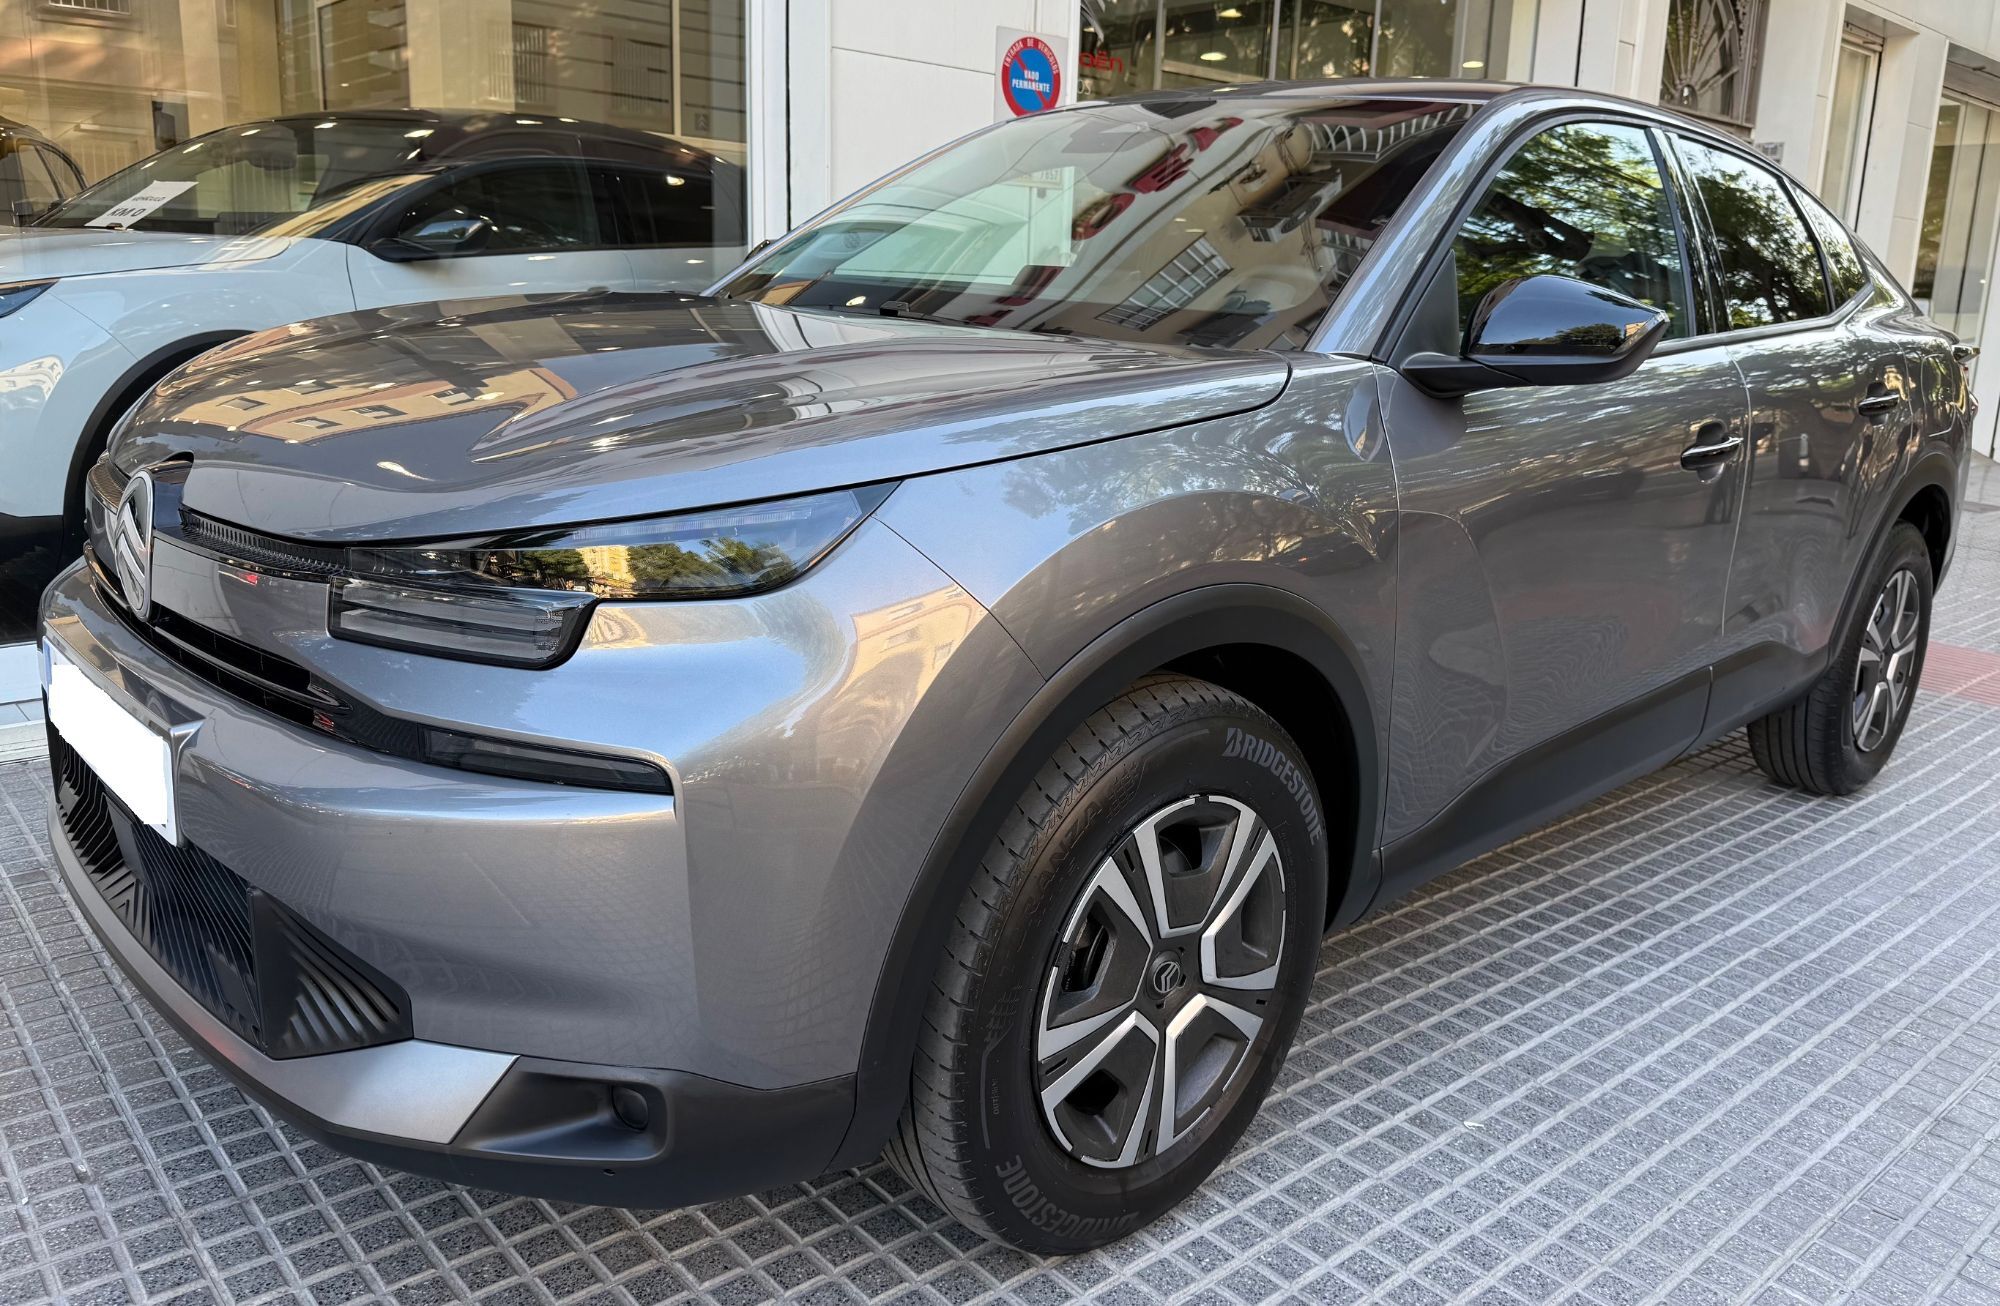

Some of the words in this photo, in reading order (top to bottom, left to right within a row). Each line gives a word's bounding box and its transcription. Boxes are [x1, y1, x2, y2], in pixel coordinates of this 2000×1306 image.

[1004, 40, 1024, 68] ENTRADA
[1026, 38, 1034, 48] DE
[1011, 78, 1050, 93] PERMANENTE
[1023, 69, 1040, 80] VADO
[108, 207, 135, 217] KM
[1222, 727, 1323, 846] BRIDGESTONE
[995, 1154, 1141, 1238] BRIDGESTONE
